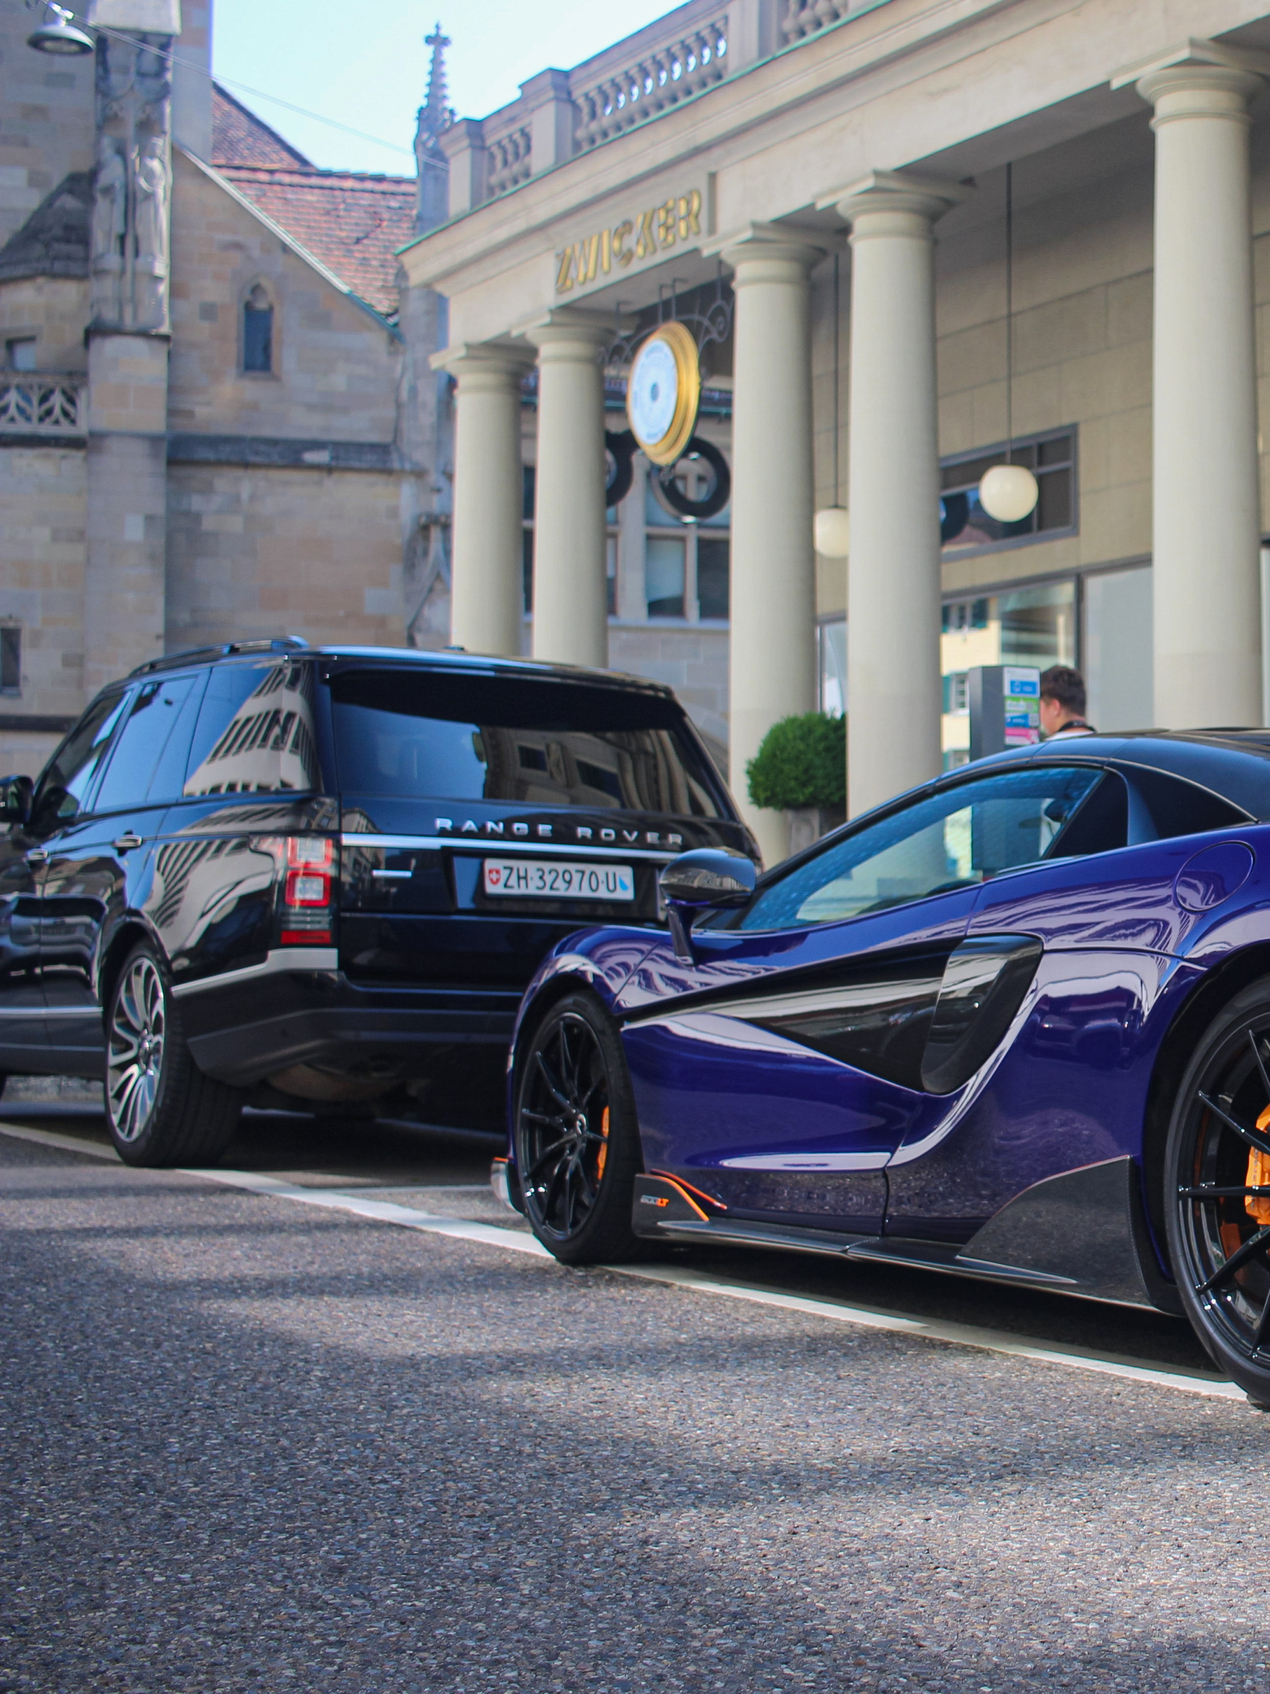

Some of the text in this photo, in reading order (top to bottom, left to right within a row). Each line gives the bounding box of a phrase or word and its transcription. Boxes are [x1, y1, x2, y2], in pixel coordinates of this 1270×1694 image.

[556, 189, 702, 294] ZWICKER
[434, 817, 684, 847] RANGE ROVER
